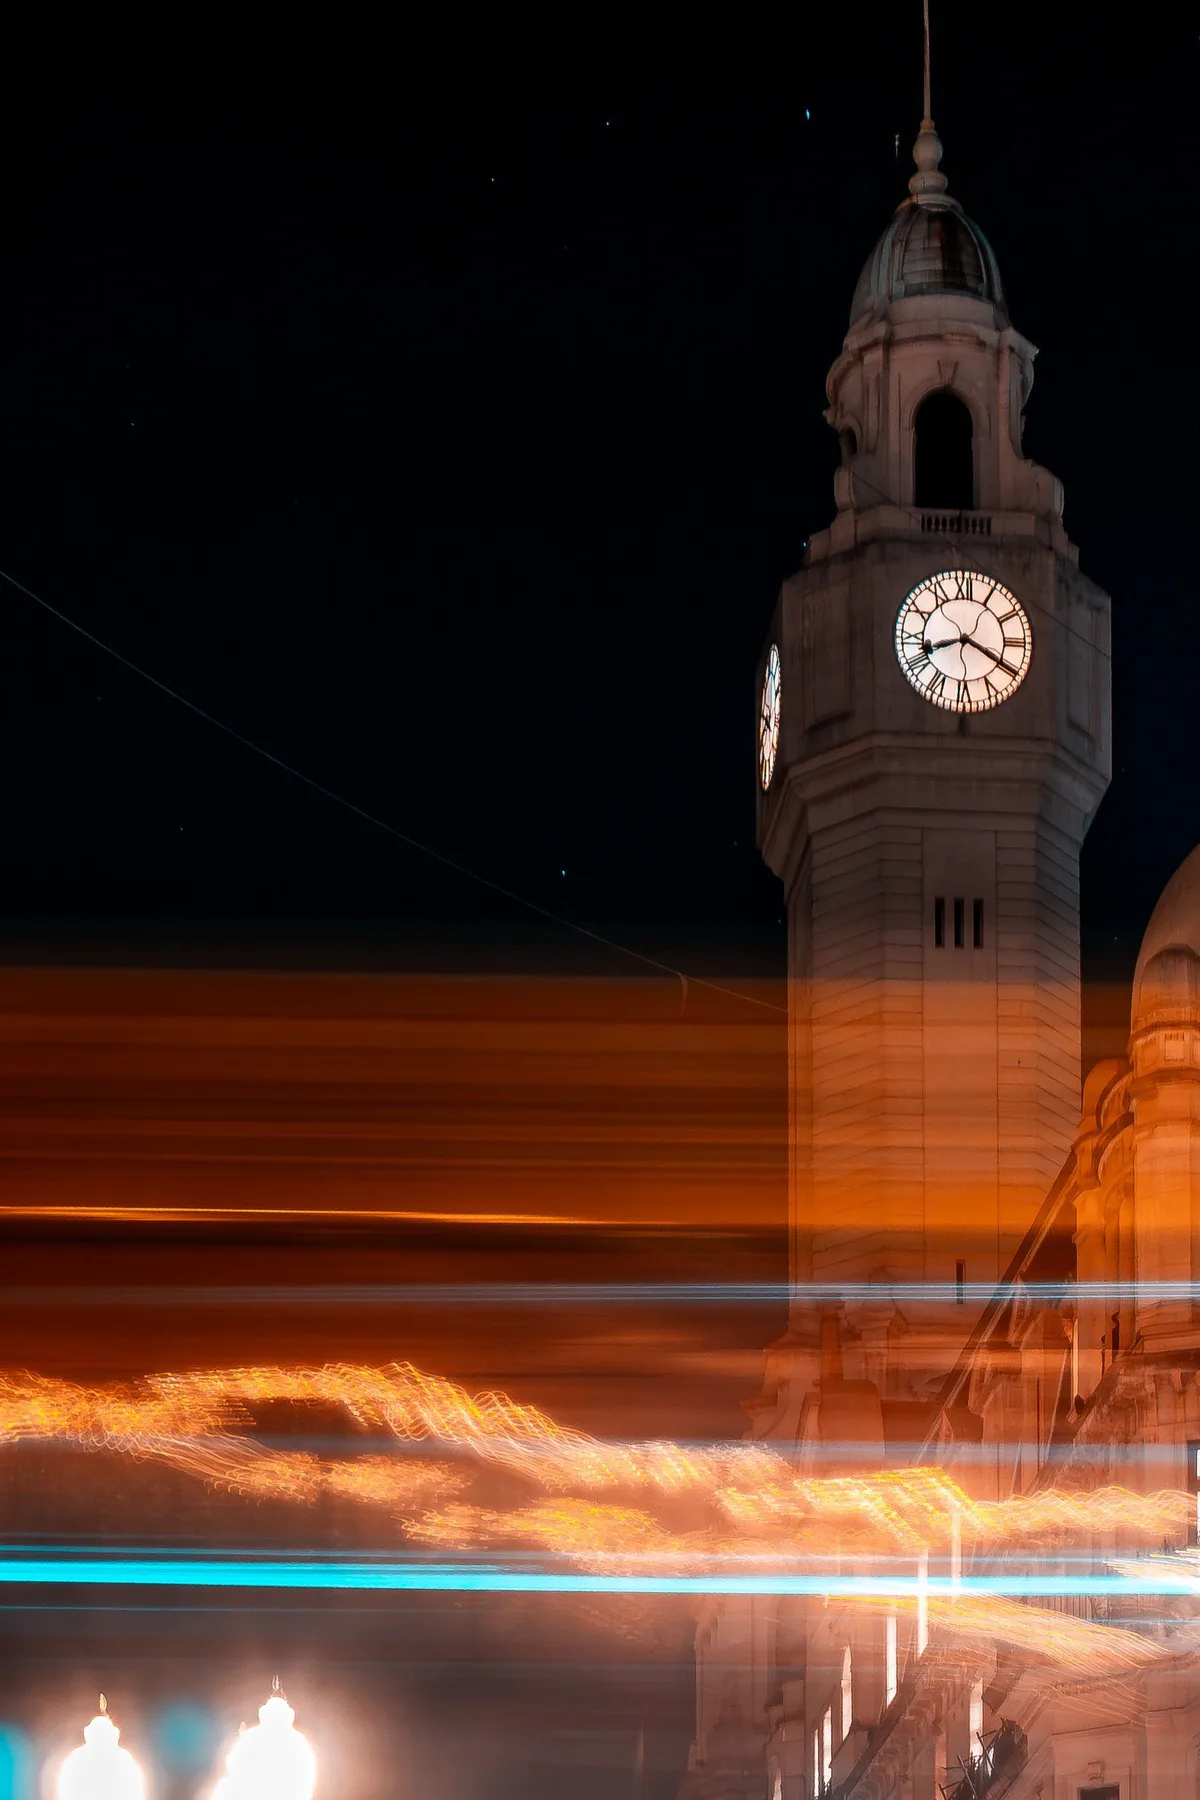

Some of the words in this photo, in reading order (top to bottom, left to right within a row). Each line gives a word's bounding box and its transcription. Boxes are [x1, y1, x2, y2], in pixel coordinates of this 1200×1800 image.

[955, 577, 973, 601] XII
[997, 608, 1020, 624] II
[1003, 636, 1026, 648] III
